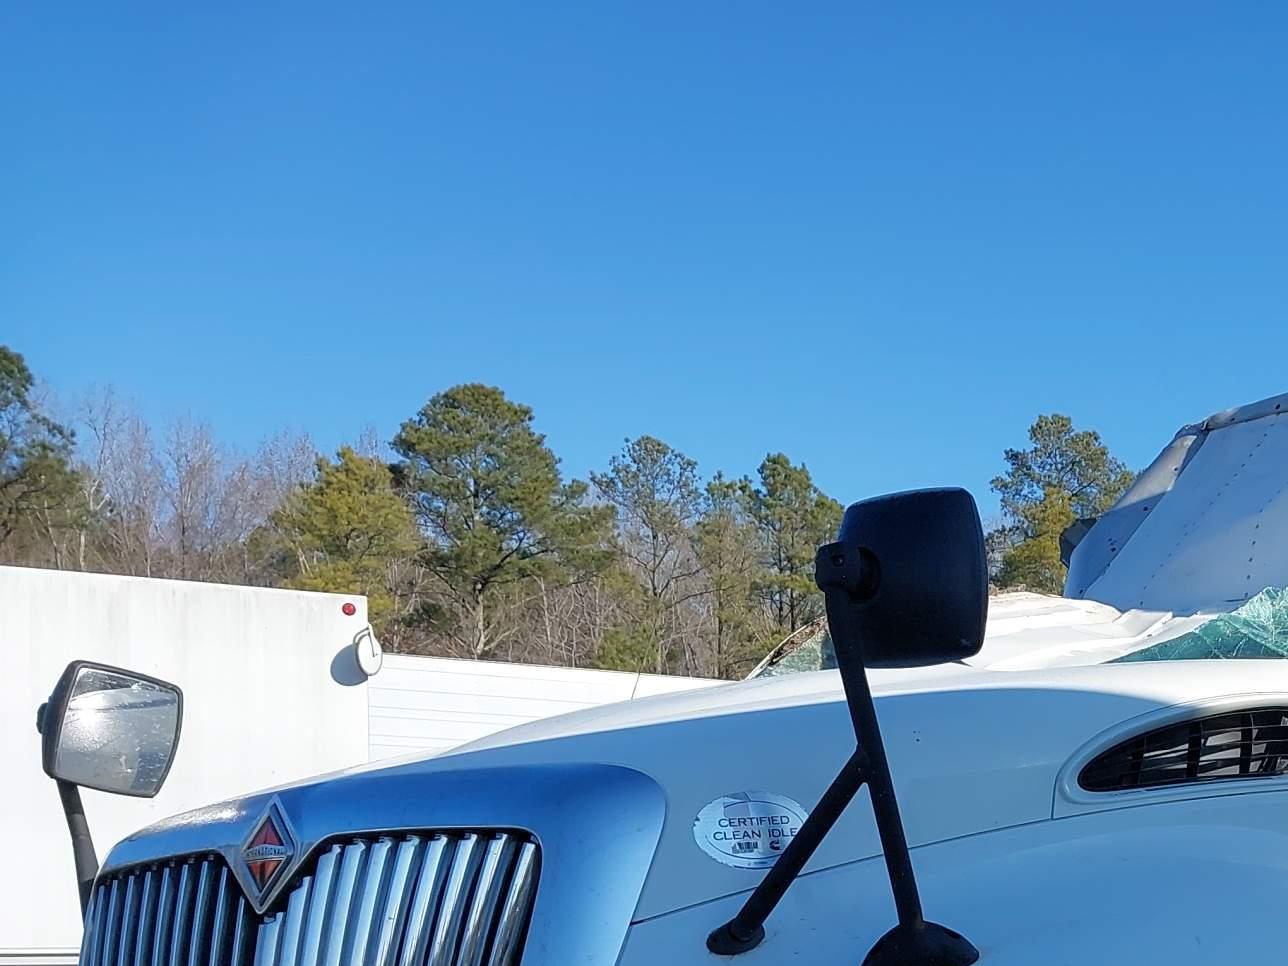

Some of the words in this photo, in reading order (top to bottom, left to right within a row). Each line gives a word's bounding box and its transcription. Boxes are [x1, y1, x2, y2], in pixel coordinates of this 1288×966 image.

[718, 815, 790, 828] CERTIFIED
[713, 830, 761, 840] CLEAN
[768, 828, 798, 838] IDLE
